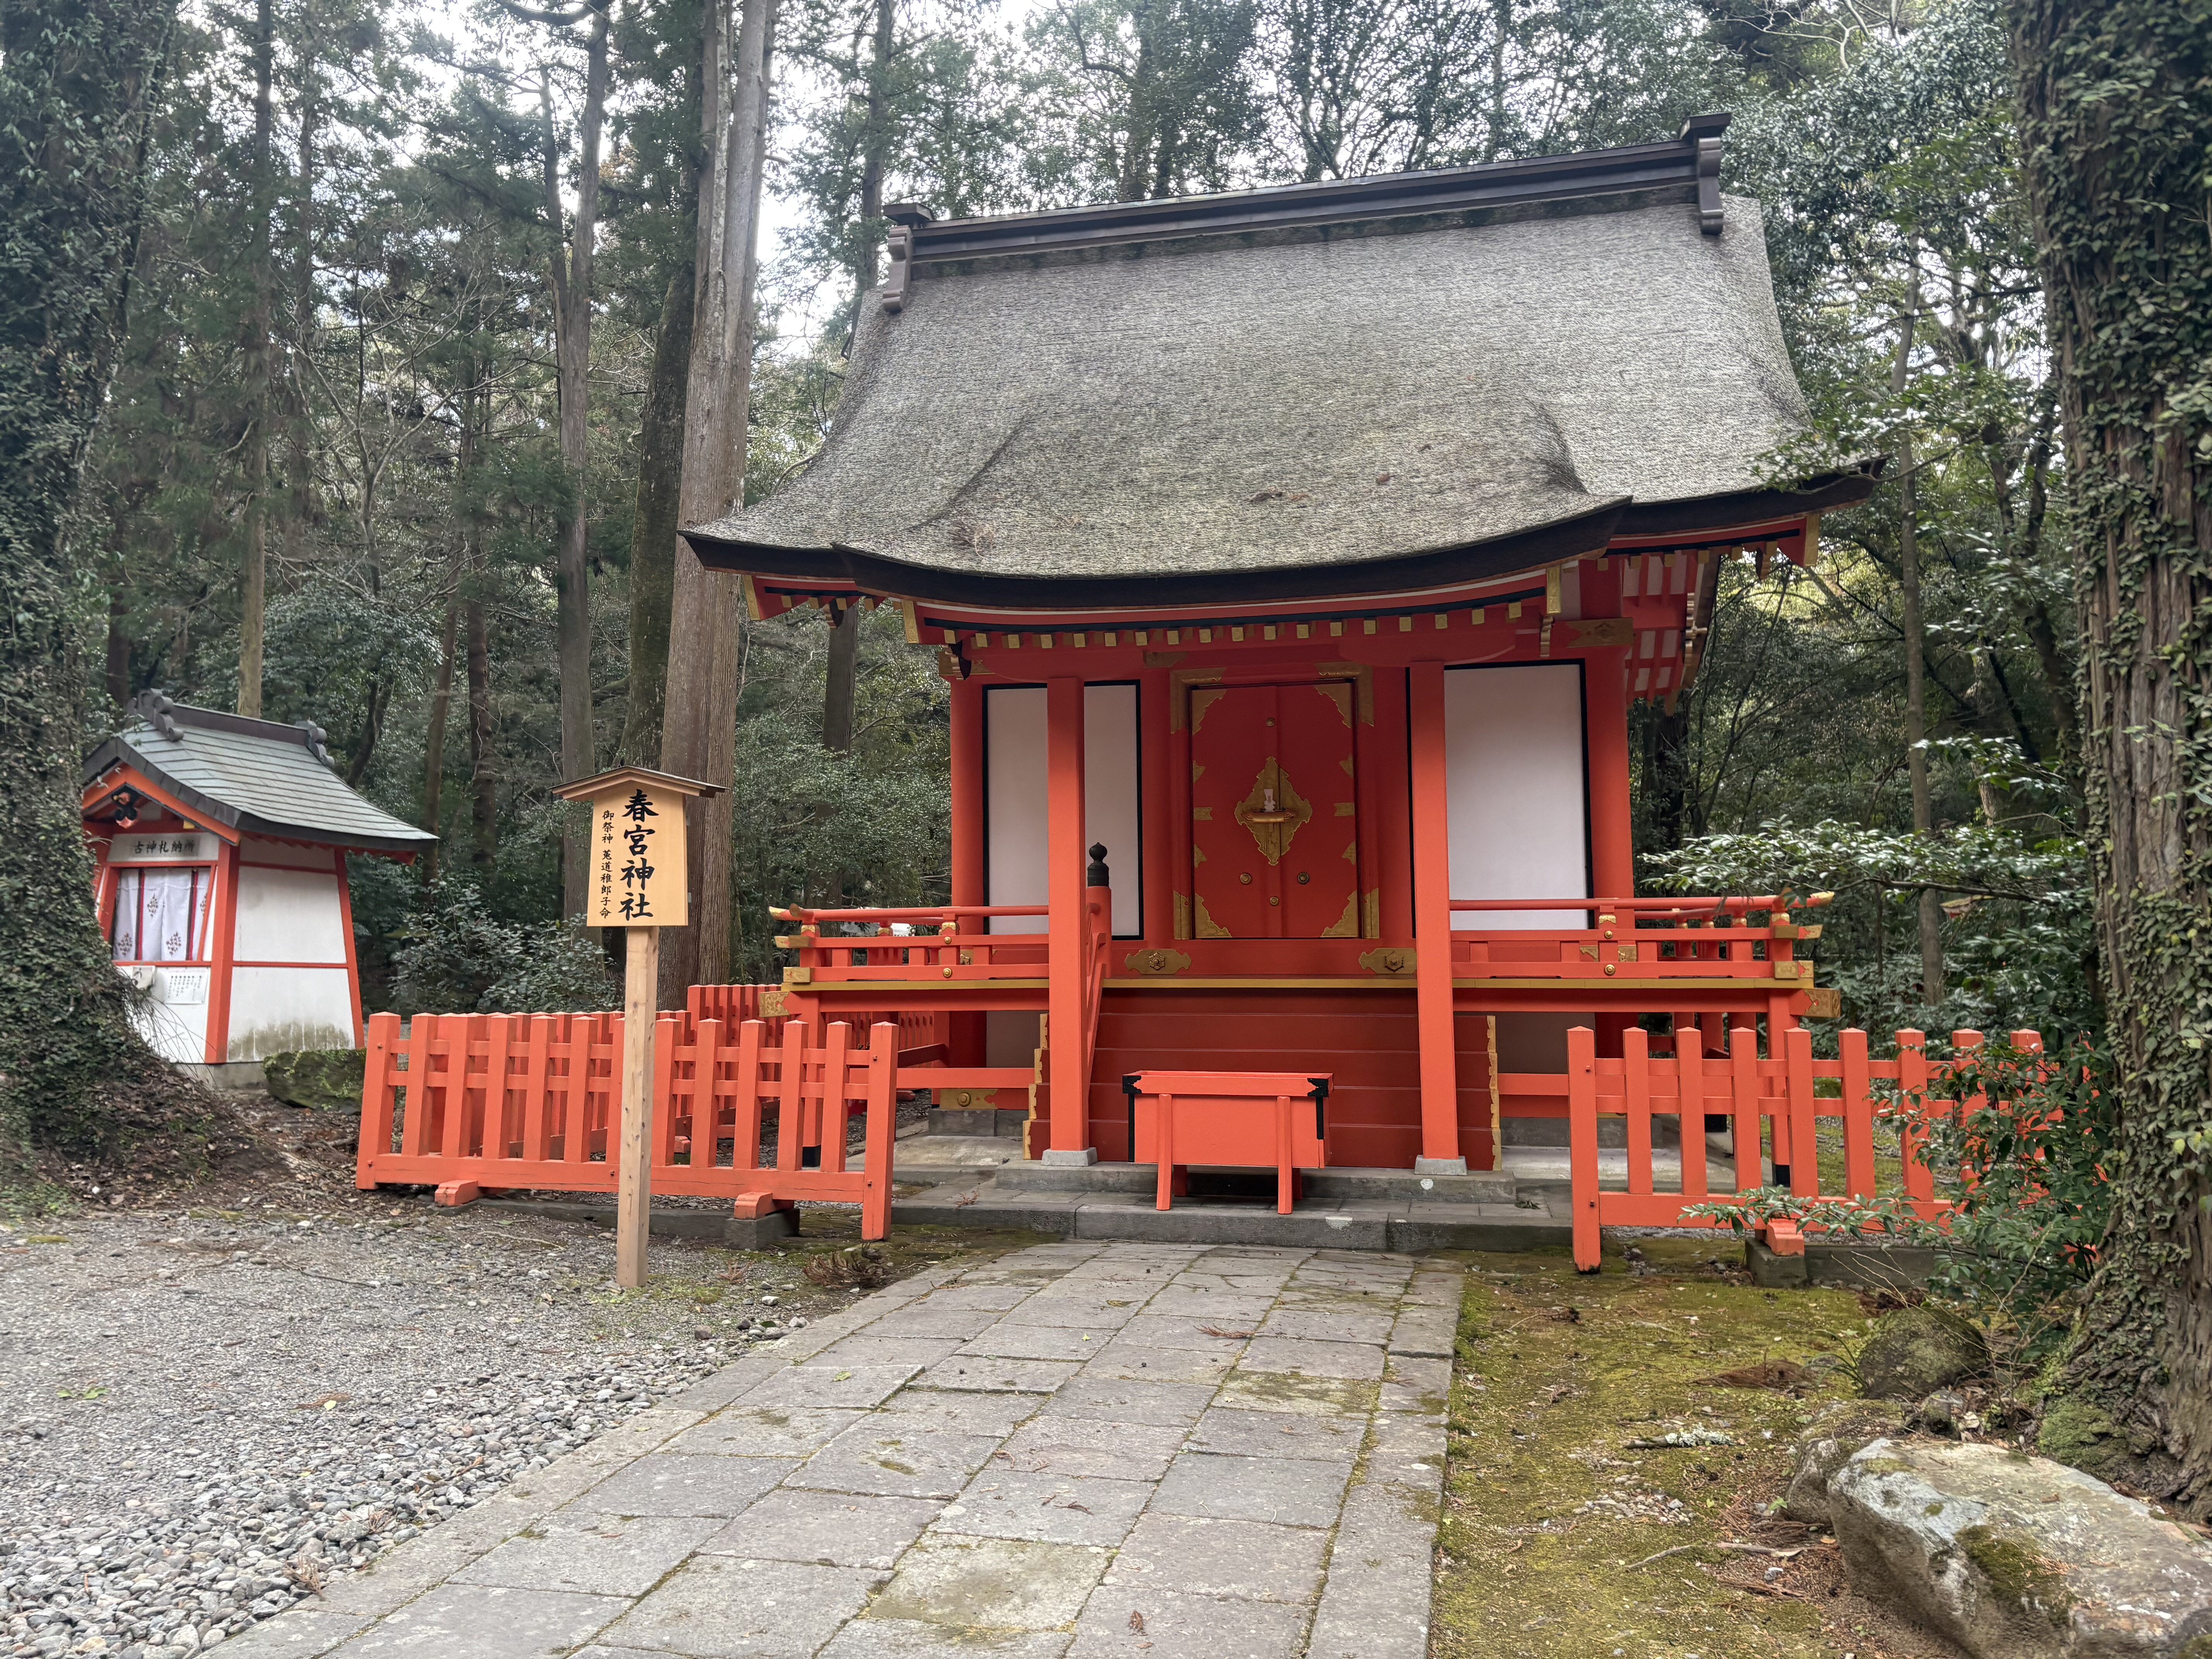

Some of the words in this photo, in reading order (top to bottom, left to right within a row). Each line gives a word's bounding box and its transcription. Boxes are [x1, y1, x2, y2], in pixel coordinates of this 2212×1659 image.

[602, 810, 614, 843] 御祭神
[134, 840, 195, 854] 古神札納所
[618, 789, 659, 921] 春宮神社
